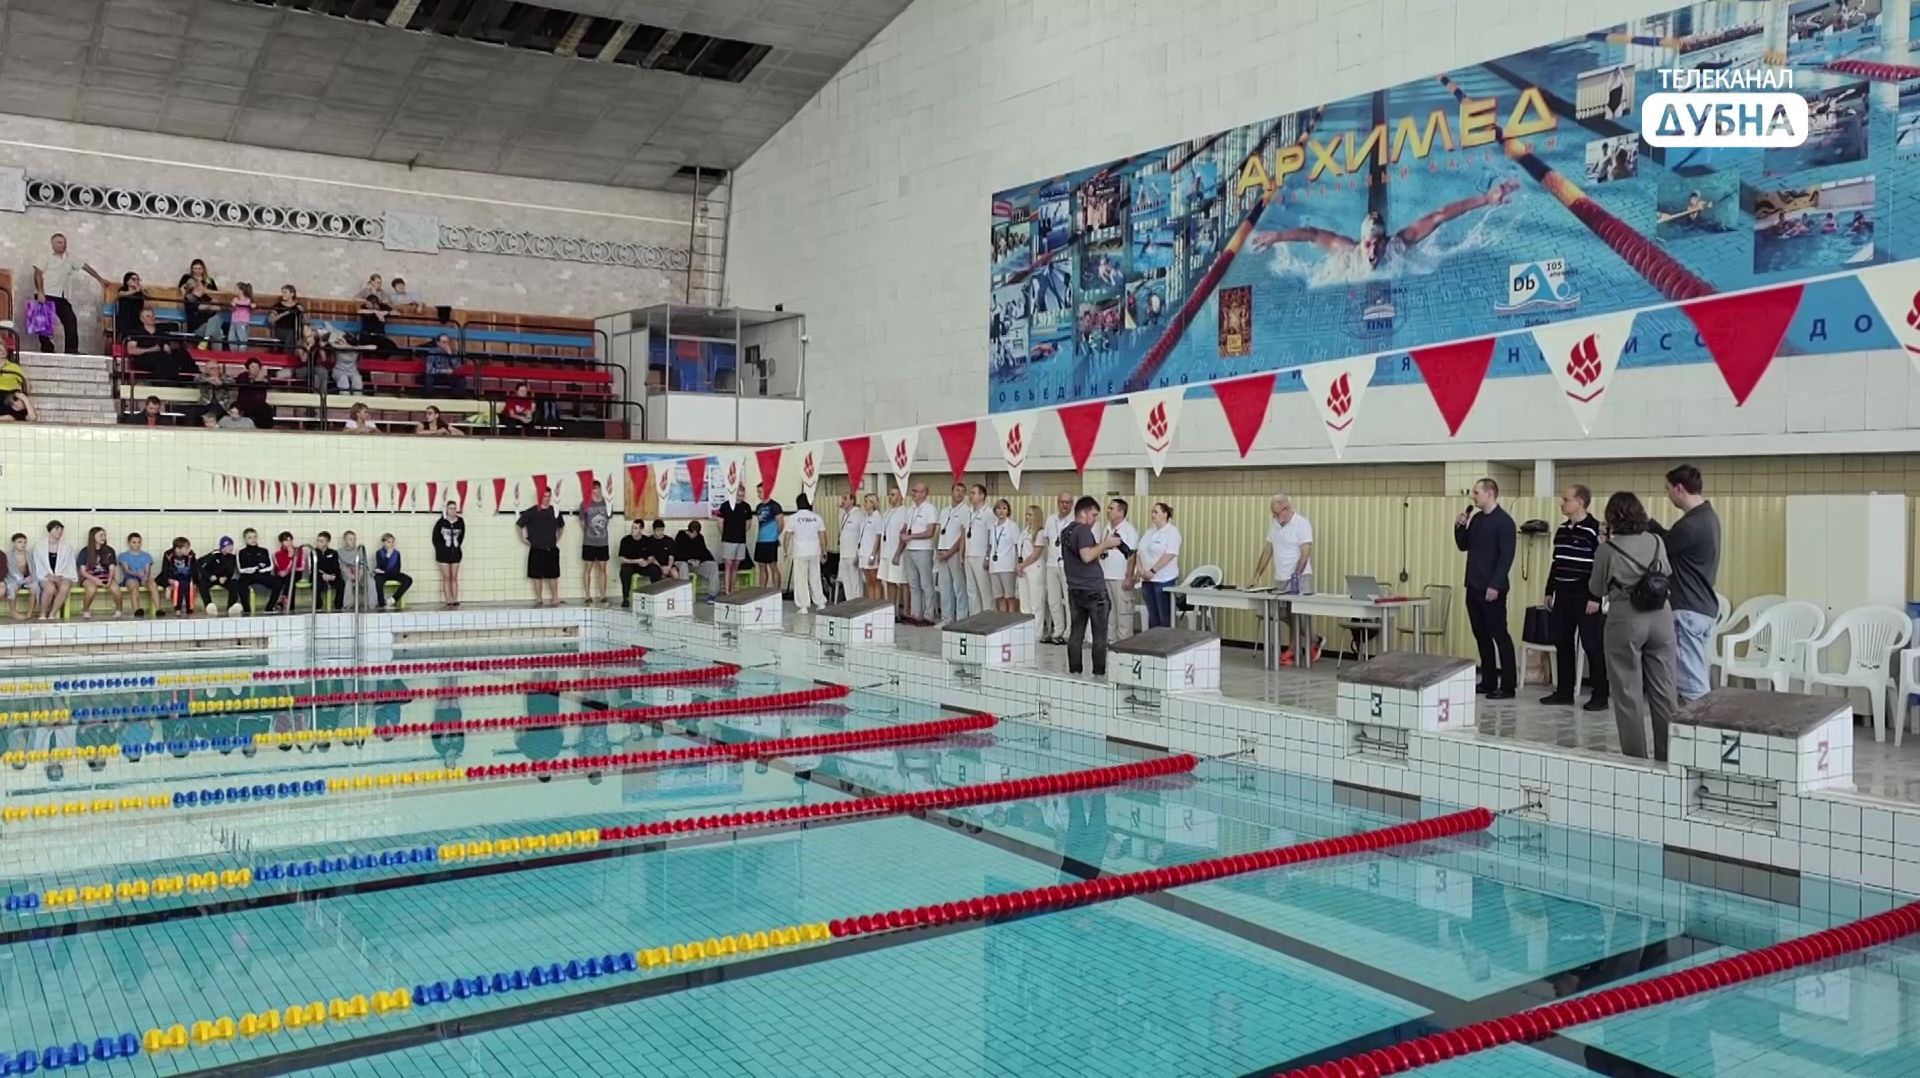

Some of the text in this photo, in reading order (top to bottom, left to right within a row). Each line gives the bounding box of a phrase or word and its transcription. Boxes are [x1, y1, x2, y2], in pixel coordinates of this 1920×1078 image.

[1236, 86, 1558, 198] АРХИМЕД
[1546, 261, 1563, 273] 105
[1513, 275, 1536, 292] Db
[667, 598, 675, 610] 8
[724, 605, 731, 619] 7
[755, 607, 763, 621] 7
[828, 620, 835, 636] 6
[864, 622, 873, 640] 6
[959, 637, 967, 655] 5
[1001, 643, 1011, 662] 5
[1132, 659, 1142, 680] 4
[1371, 692, 1382, 717] 3
[1438, 698, 1450, 722] 3
[1721, 732, 1740, 766] 2
[1817, 740, 1830, 770] 2
